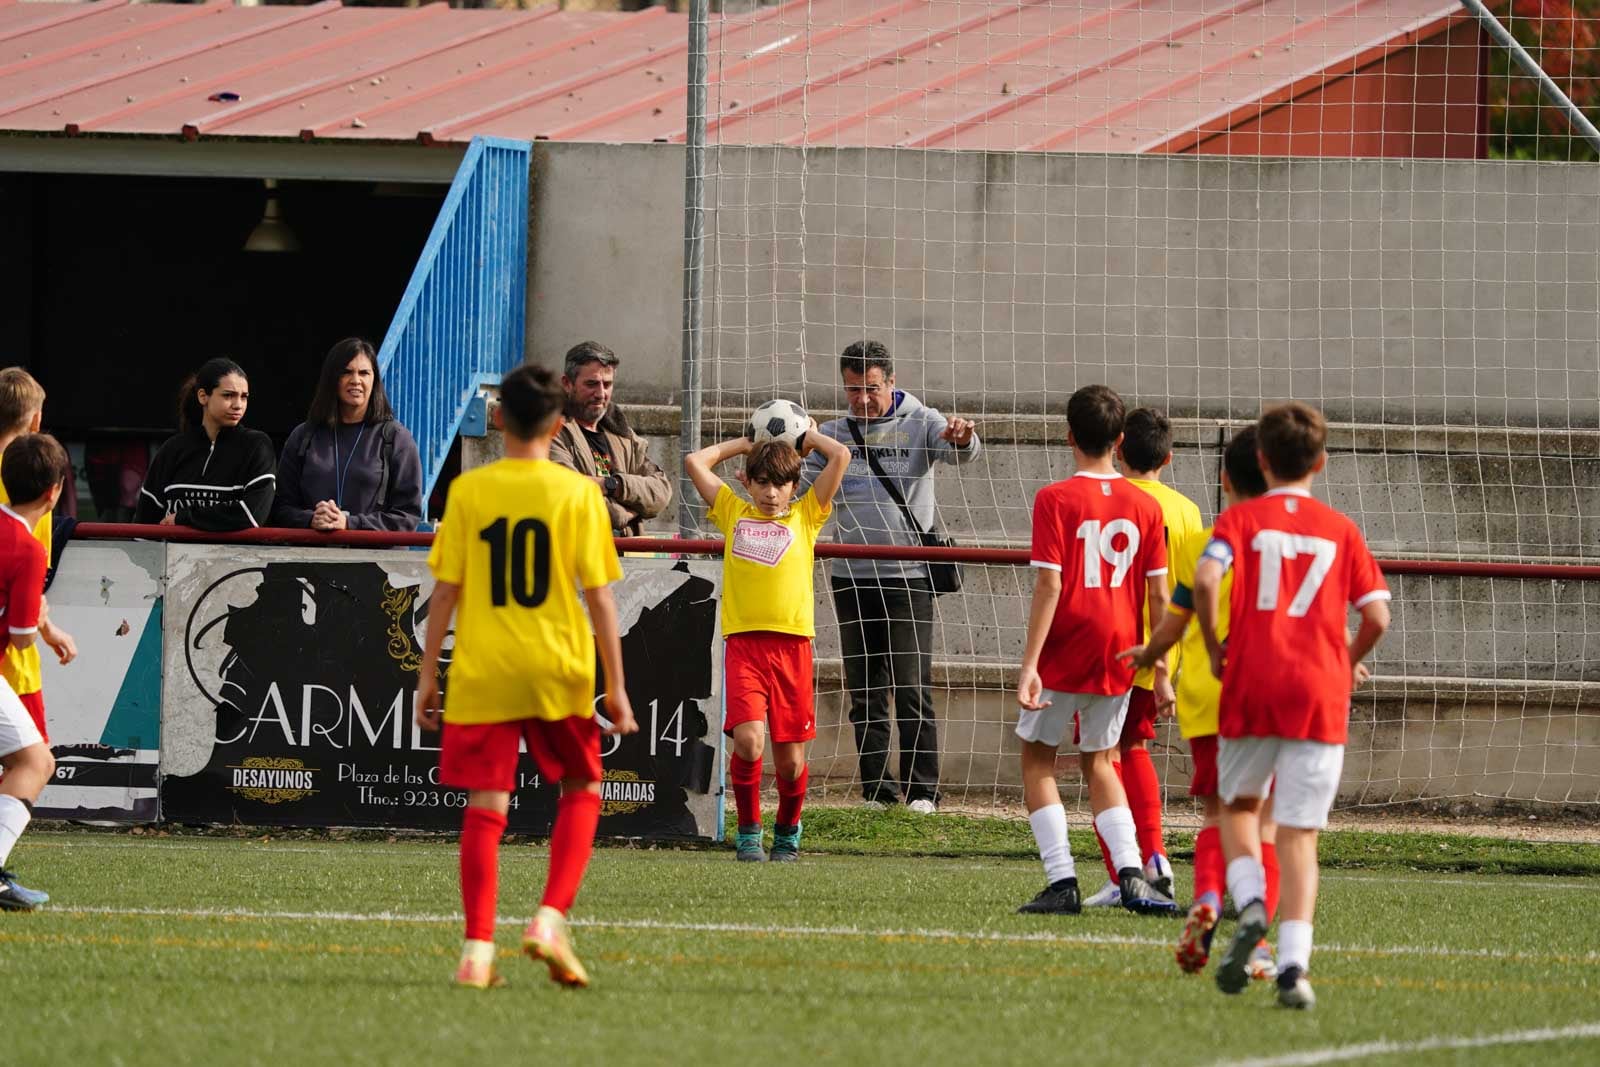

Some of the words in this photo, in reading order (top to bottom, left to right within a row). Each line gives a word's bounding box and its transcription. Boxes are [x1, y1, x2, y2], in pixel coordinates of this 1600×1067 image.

[480, 517, 551, 608] 10
[1076, 519, 1140, 588] 19
[1252, 529, 1337, 617] 17
[649, 698, 688, 756] 14
[233, 768, 313, 790] DESAYUNOS
[338, 763, 379, 783] Plaza
[383, 764, 400, 784] de
[404, 765, 423, 785] las
[520, 772, 541, 788] 14
[403, 791, 439, 806] 923
